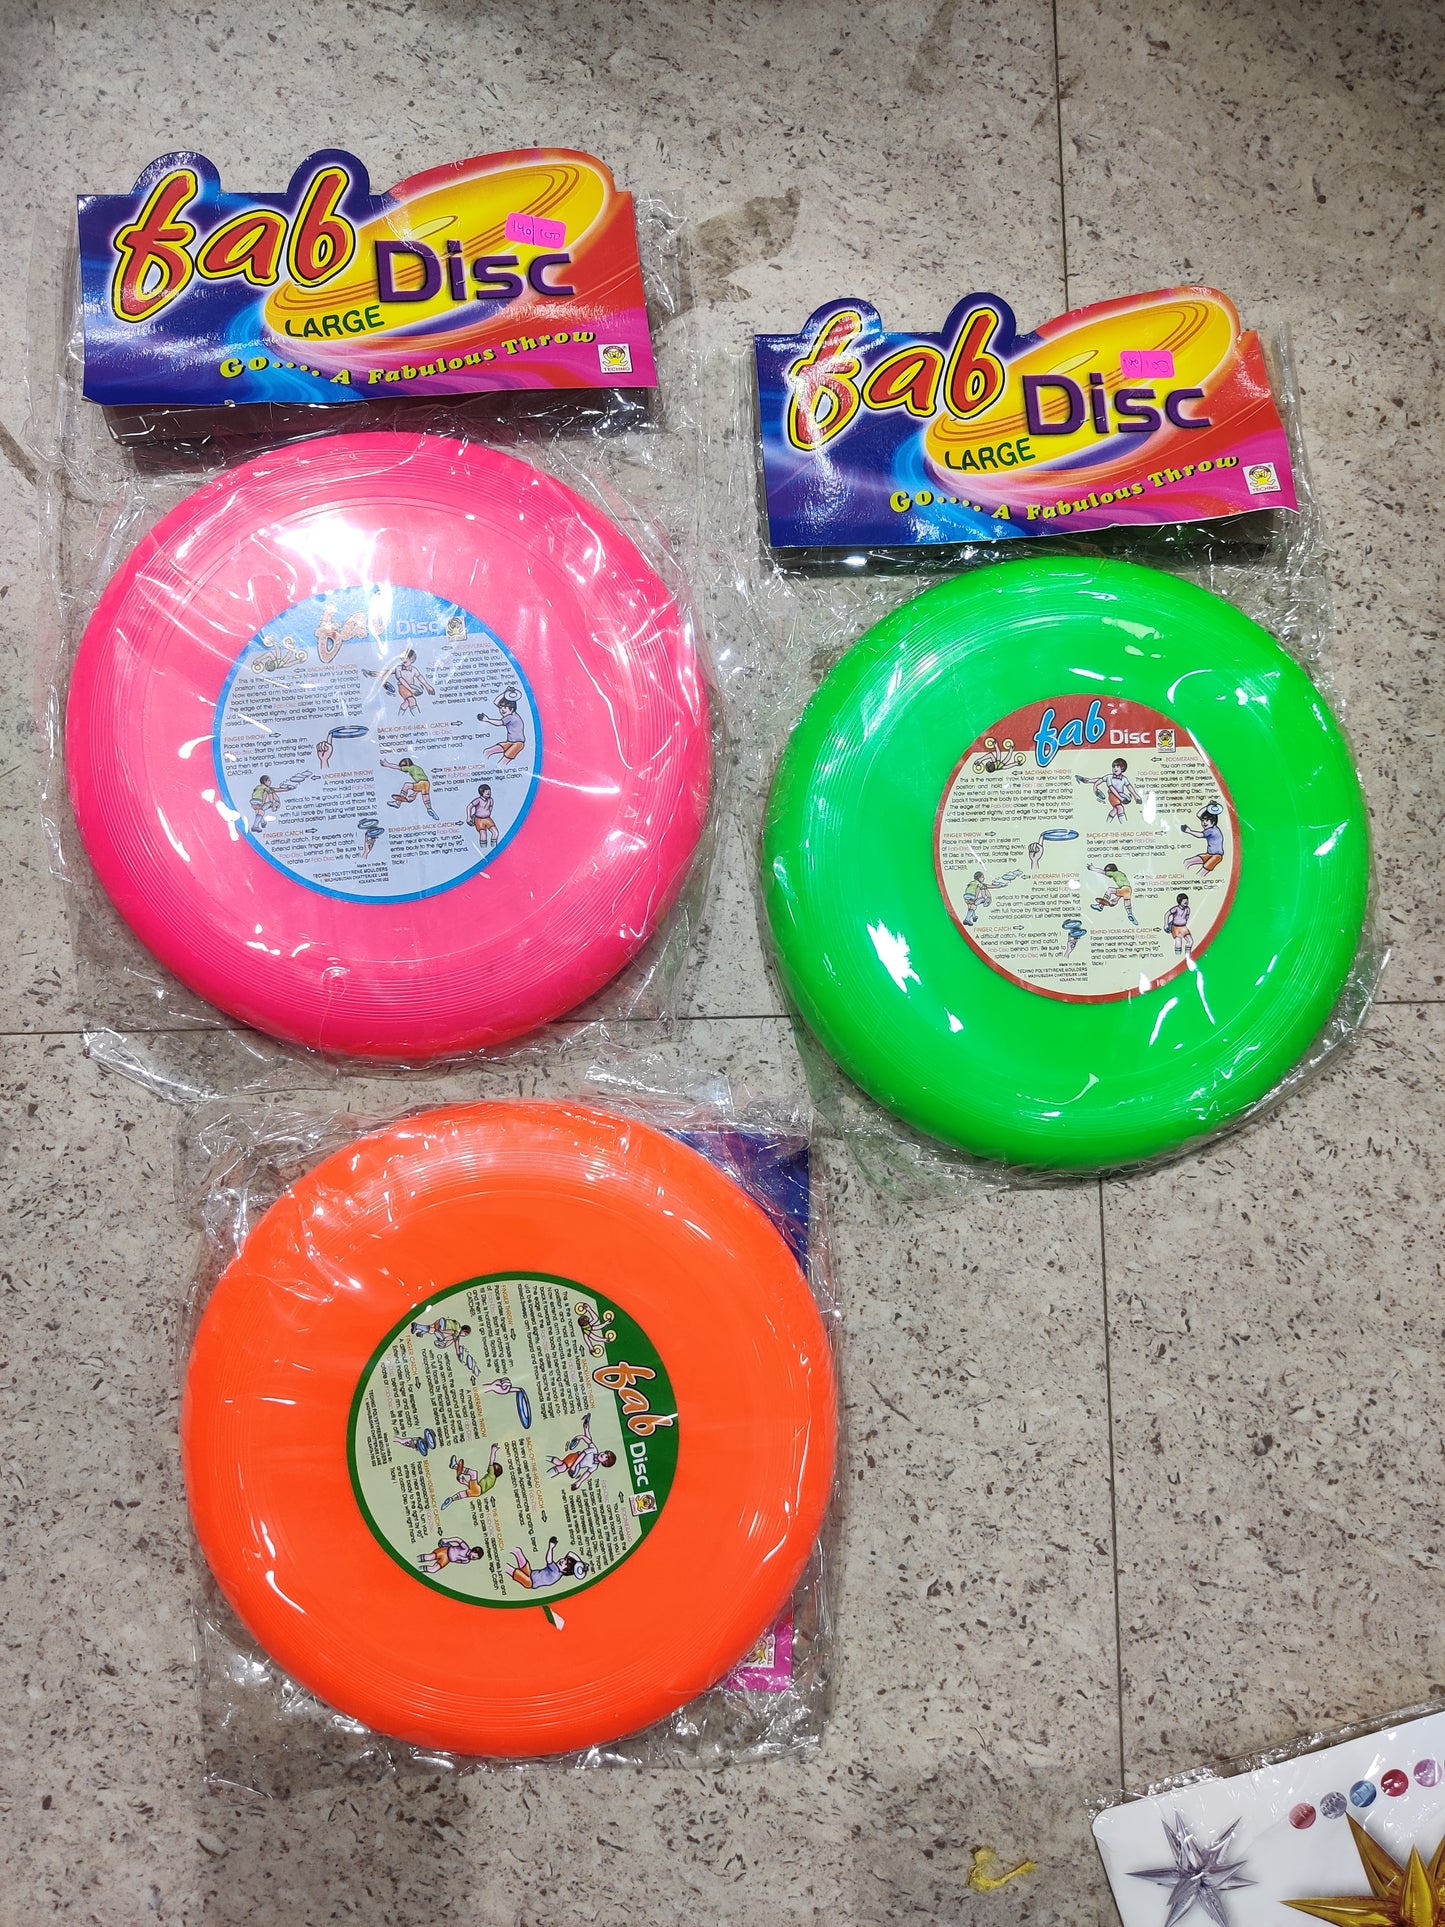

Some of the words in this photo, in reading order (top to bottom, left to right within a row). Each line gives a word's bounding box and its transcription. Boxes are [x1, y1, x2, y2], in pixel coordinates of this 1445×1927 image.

[113, 168, 356, 324] fab
[375, 240, 575, 303] Disc
[285, 305, 385, 338] LARGE
[330, 369, 352, 385] A
[367, 346, 496, 385] Fabulous
[501, 329, 596, 356] Throw
[788, 307, 1006, 452] fab
[1022, 372, 1212, 437] Disc
[944, 437, 1036, 471] LARGE
[991, 505, 1011, 520] A
[1026, 481, 1145, 521] Fabulous
[1147, 455, 1240, 488] Throw
[1034, 699, 1106, 767] fab
[1110, 729, 1151, 745] Disc
[592, 1361, 674, 1436] fab
[629, 1441, 649, 1488] Disc
